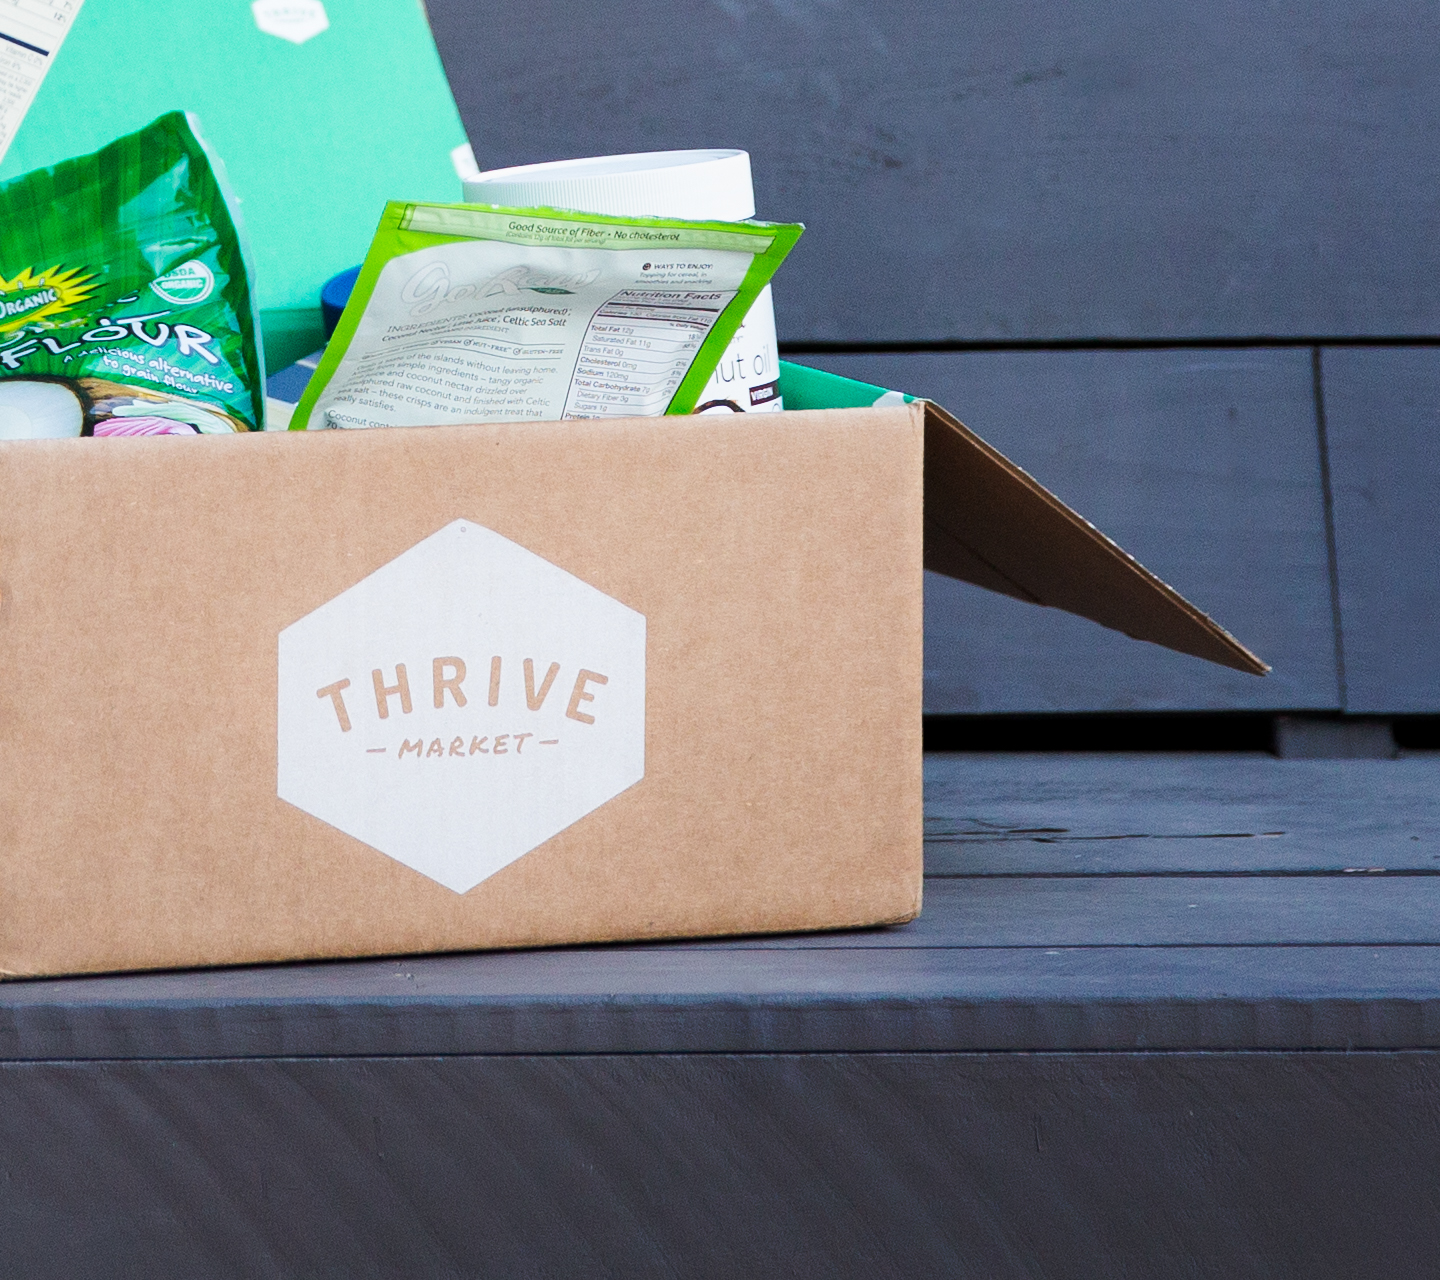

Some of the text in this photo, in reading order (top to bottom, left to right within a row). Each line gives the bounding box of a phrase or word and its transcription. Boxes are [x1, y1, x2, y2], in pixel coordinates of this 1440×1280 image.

[509, 222, 680, 240] Good Source of Fiber No cholesterol
[503, 315, 529, 326] Celtic
[531, 317, 546, 326] Sea
[548, 318, 567, 326] Salt
[0, 312, 218, 368] FLOUR
[593, 335, 624, 344] Saturated
[584, 346, 601, 354] Trans
[615, 348, 624, 356] 0g
[753, 344, 771, 375] oil
[434, 354, 464, 365] islands
[466, 360, 500, 373] without
[503, 366, 531, 375] leaving
[580, 356, 621, 366] Cholesterol
[103, 355, 199, 394] to grain flour
[149, 357, 233, 393] alternative
[397, 361, 425, 371] simple
[428, 365, 478, 381] ingredients
[489, 377, 512, 386] tangy
[514, 377, 543, 386] organic
[577, 368, 604, 376] Sodium
[606, 371, 629, 380] 120mg
[406, 373, 443, 385] coconut
[445, 380, 473, 392] nectar
[475, 386, 508, 395] drizzled
[593, 381, 640, 392] Carbohydrate
[380, 389, 403, 400] these
[406, 395, 432, 408] crisps
[464, 407, 502, 417] indulgent
[526, 408, 542, 417] that
[415, 386, 451, 400] coconut
[454, 395, 471, 404] and
[526, 397, 550, 406] Celtic
[577, 390, 600, 401] Dietary
[359, 399, 396, 412] satisfies.
[574, 402, 597, 410] Sugars
[328, 410, 367, 425] Coconut
[316, 656, 609, 732] THRIVE
[398, 733, 533, 759] MARKET
